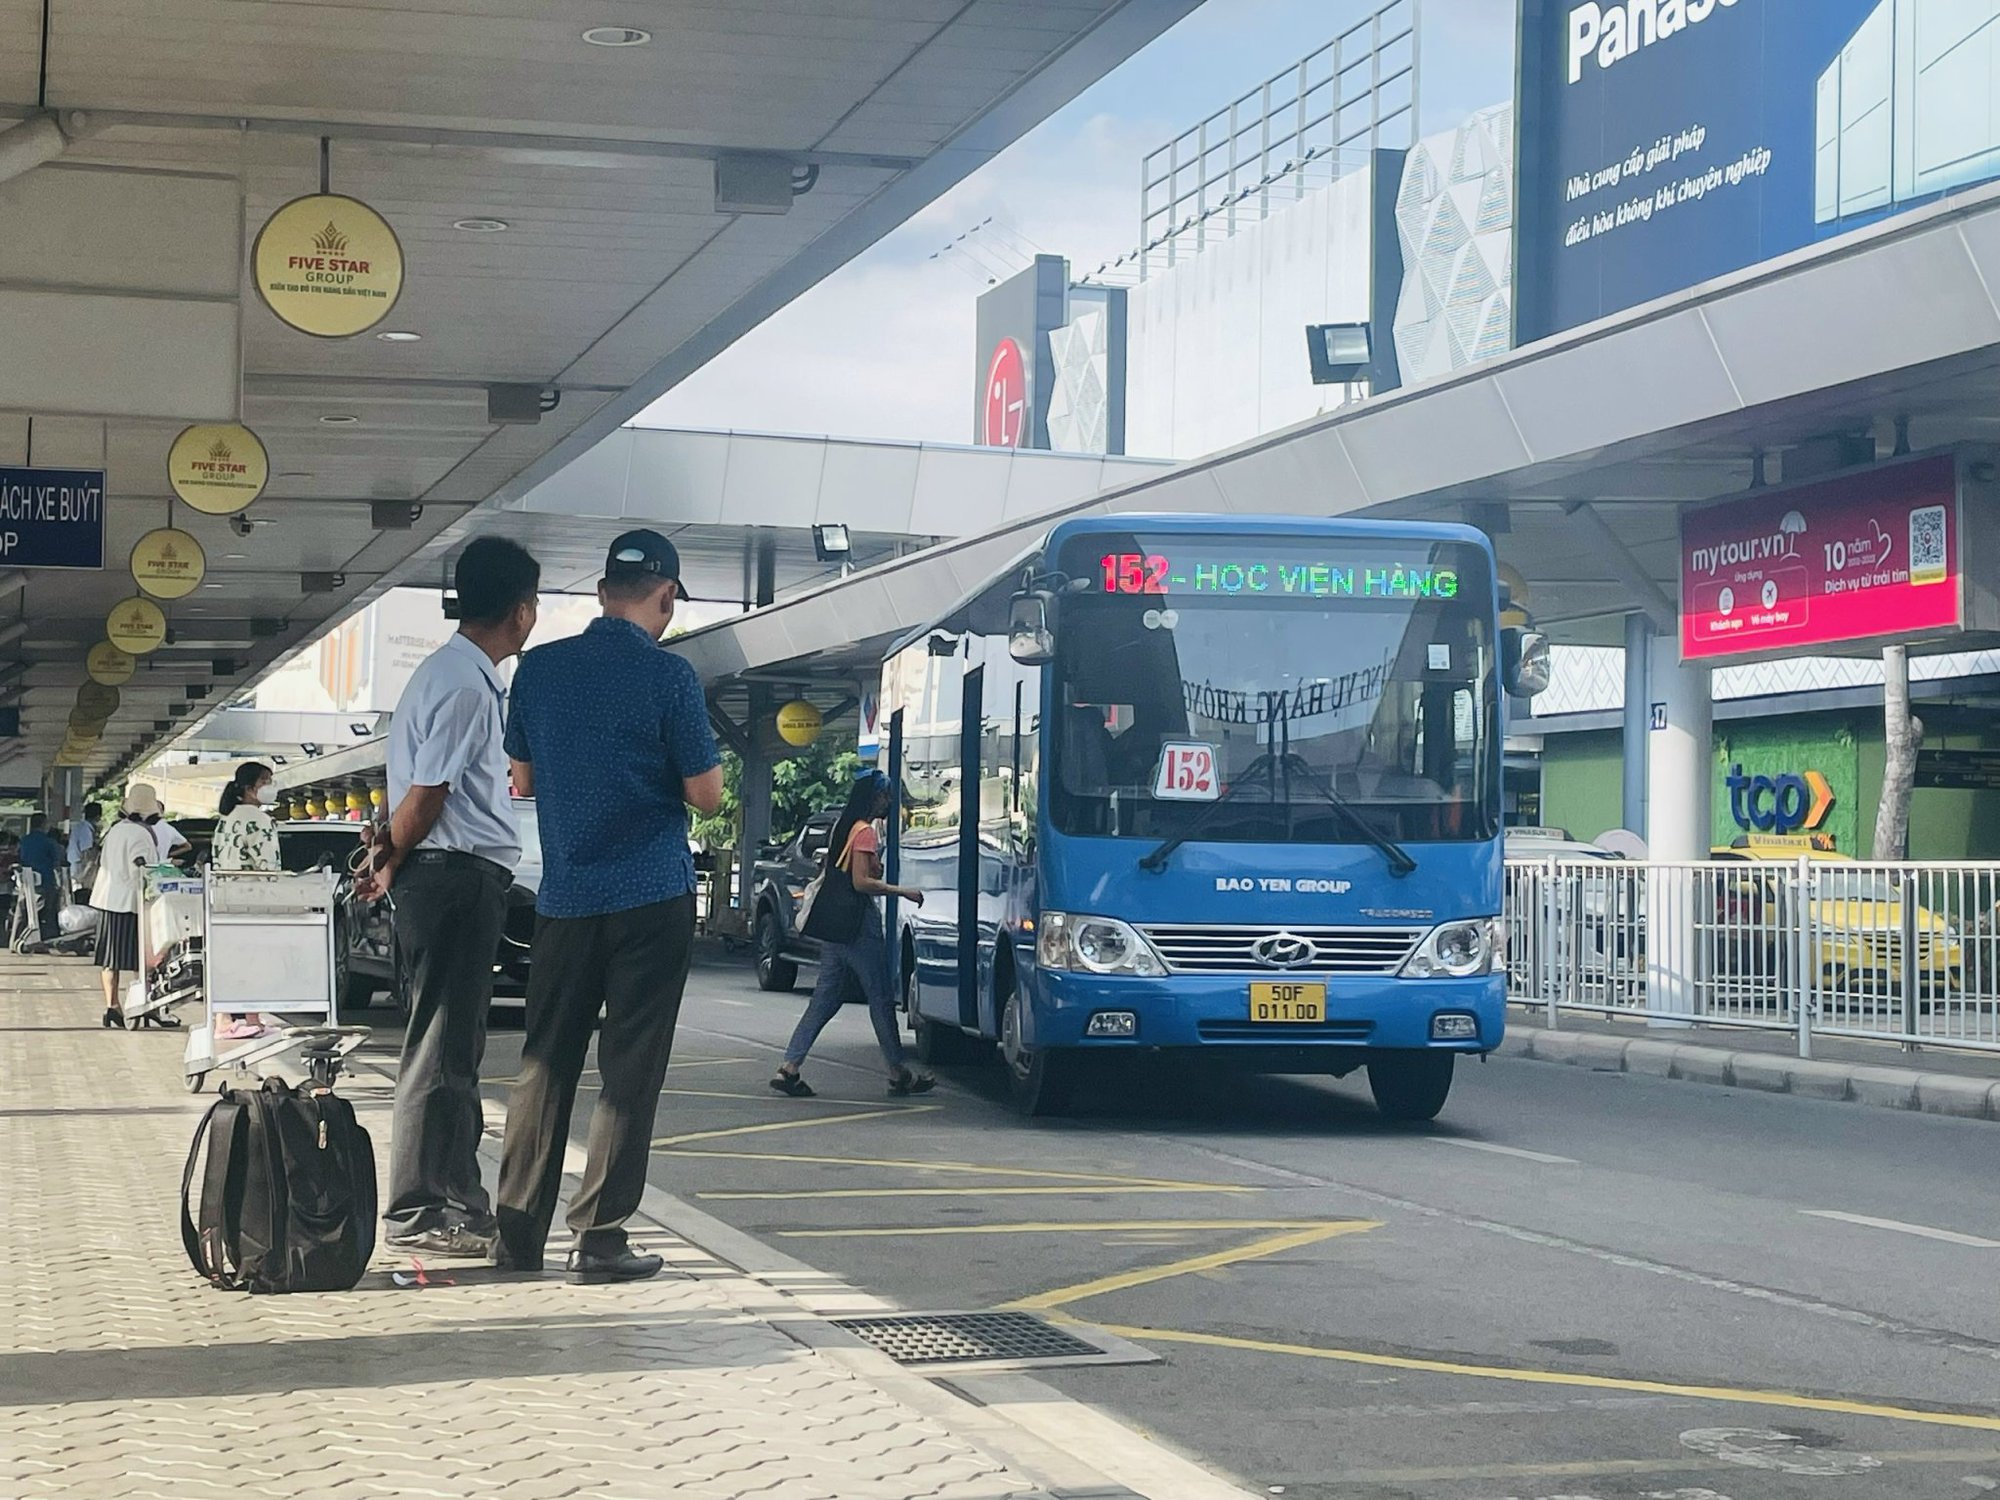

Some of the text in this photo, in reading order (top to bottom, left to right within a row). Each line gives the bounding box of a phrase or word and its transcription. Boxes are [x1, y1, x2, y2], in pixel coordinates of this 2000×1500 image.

[1566, 124, 1706, 201] Nhà cung cấp giải pháp
[1565, 146, 1772, 247] điều hòa không khí chuyên nghiệp
[288, 256, 370, 274] FIVE STAR
[305, 271, 354, 284] GROUP
[191, 461, 247, 474] FIVE STAR
[35, 486, 56, 521] XE
[60, 480, 100, 522] BUÝT
[1692, 534, 1785, 576] mytour.vn
[1824, 538, 1872, 572] 10 năm
[1195, 562, 1269, 597] HỌC
[1364, 561, 1459, 598] HÀNG
[1824, 578, 1847, 597] Dịch
[1847, 578, 1860, 593] vụ
[1861, 573, 1872, 588] từ
[1873, 570, 1891, 586] trái
[1165, 750, 1211, 792] 152
[1726, 763, 1811, 835] tcp
[1216, 878, 1351, 894] BAO YEN GROUP
[1272, 985, 1304, 1001] 50F
